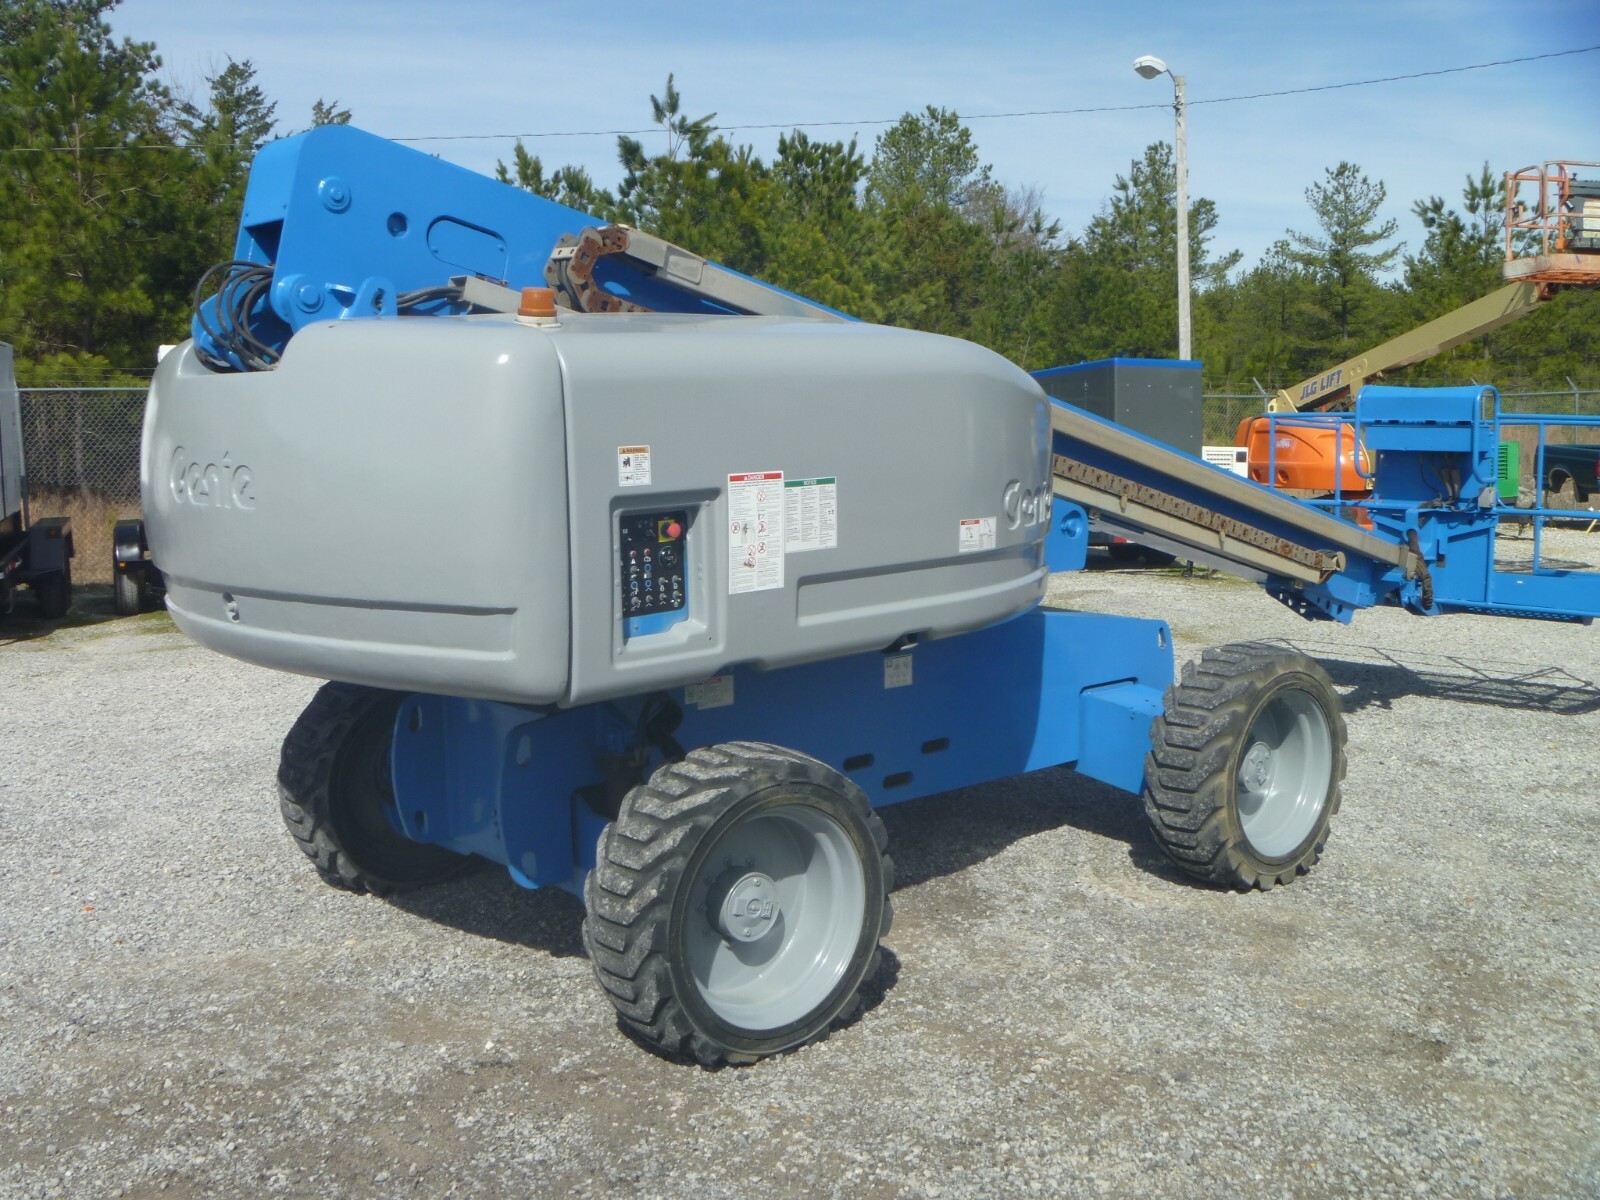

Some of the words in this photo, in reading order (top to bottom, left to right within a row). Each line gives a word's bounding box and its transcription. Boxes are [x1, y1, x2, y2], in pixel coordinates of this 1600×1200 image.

[1300, 381, 1317, 400] JLG
[1321, 369, 1342, 391] LIFT
[171, 445, 256, 510] Genie
